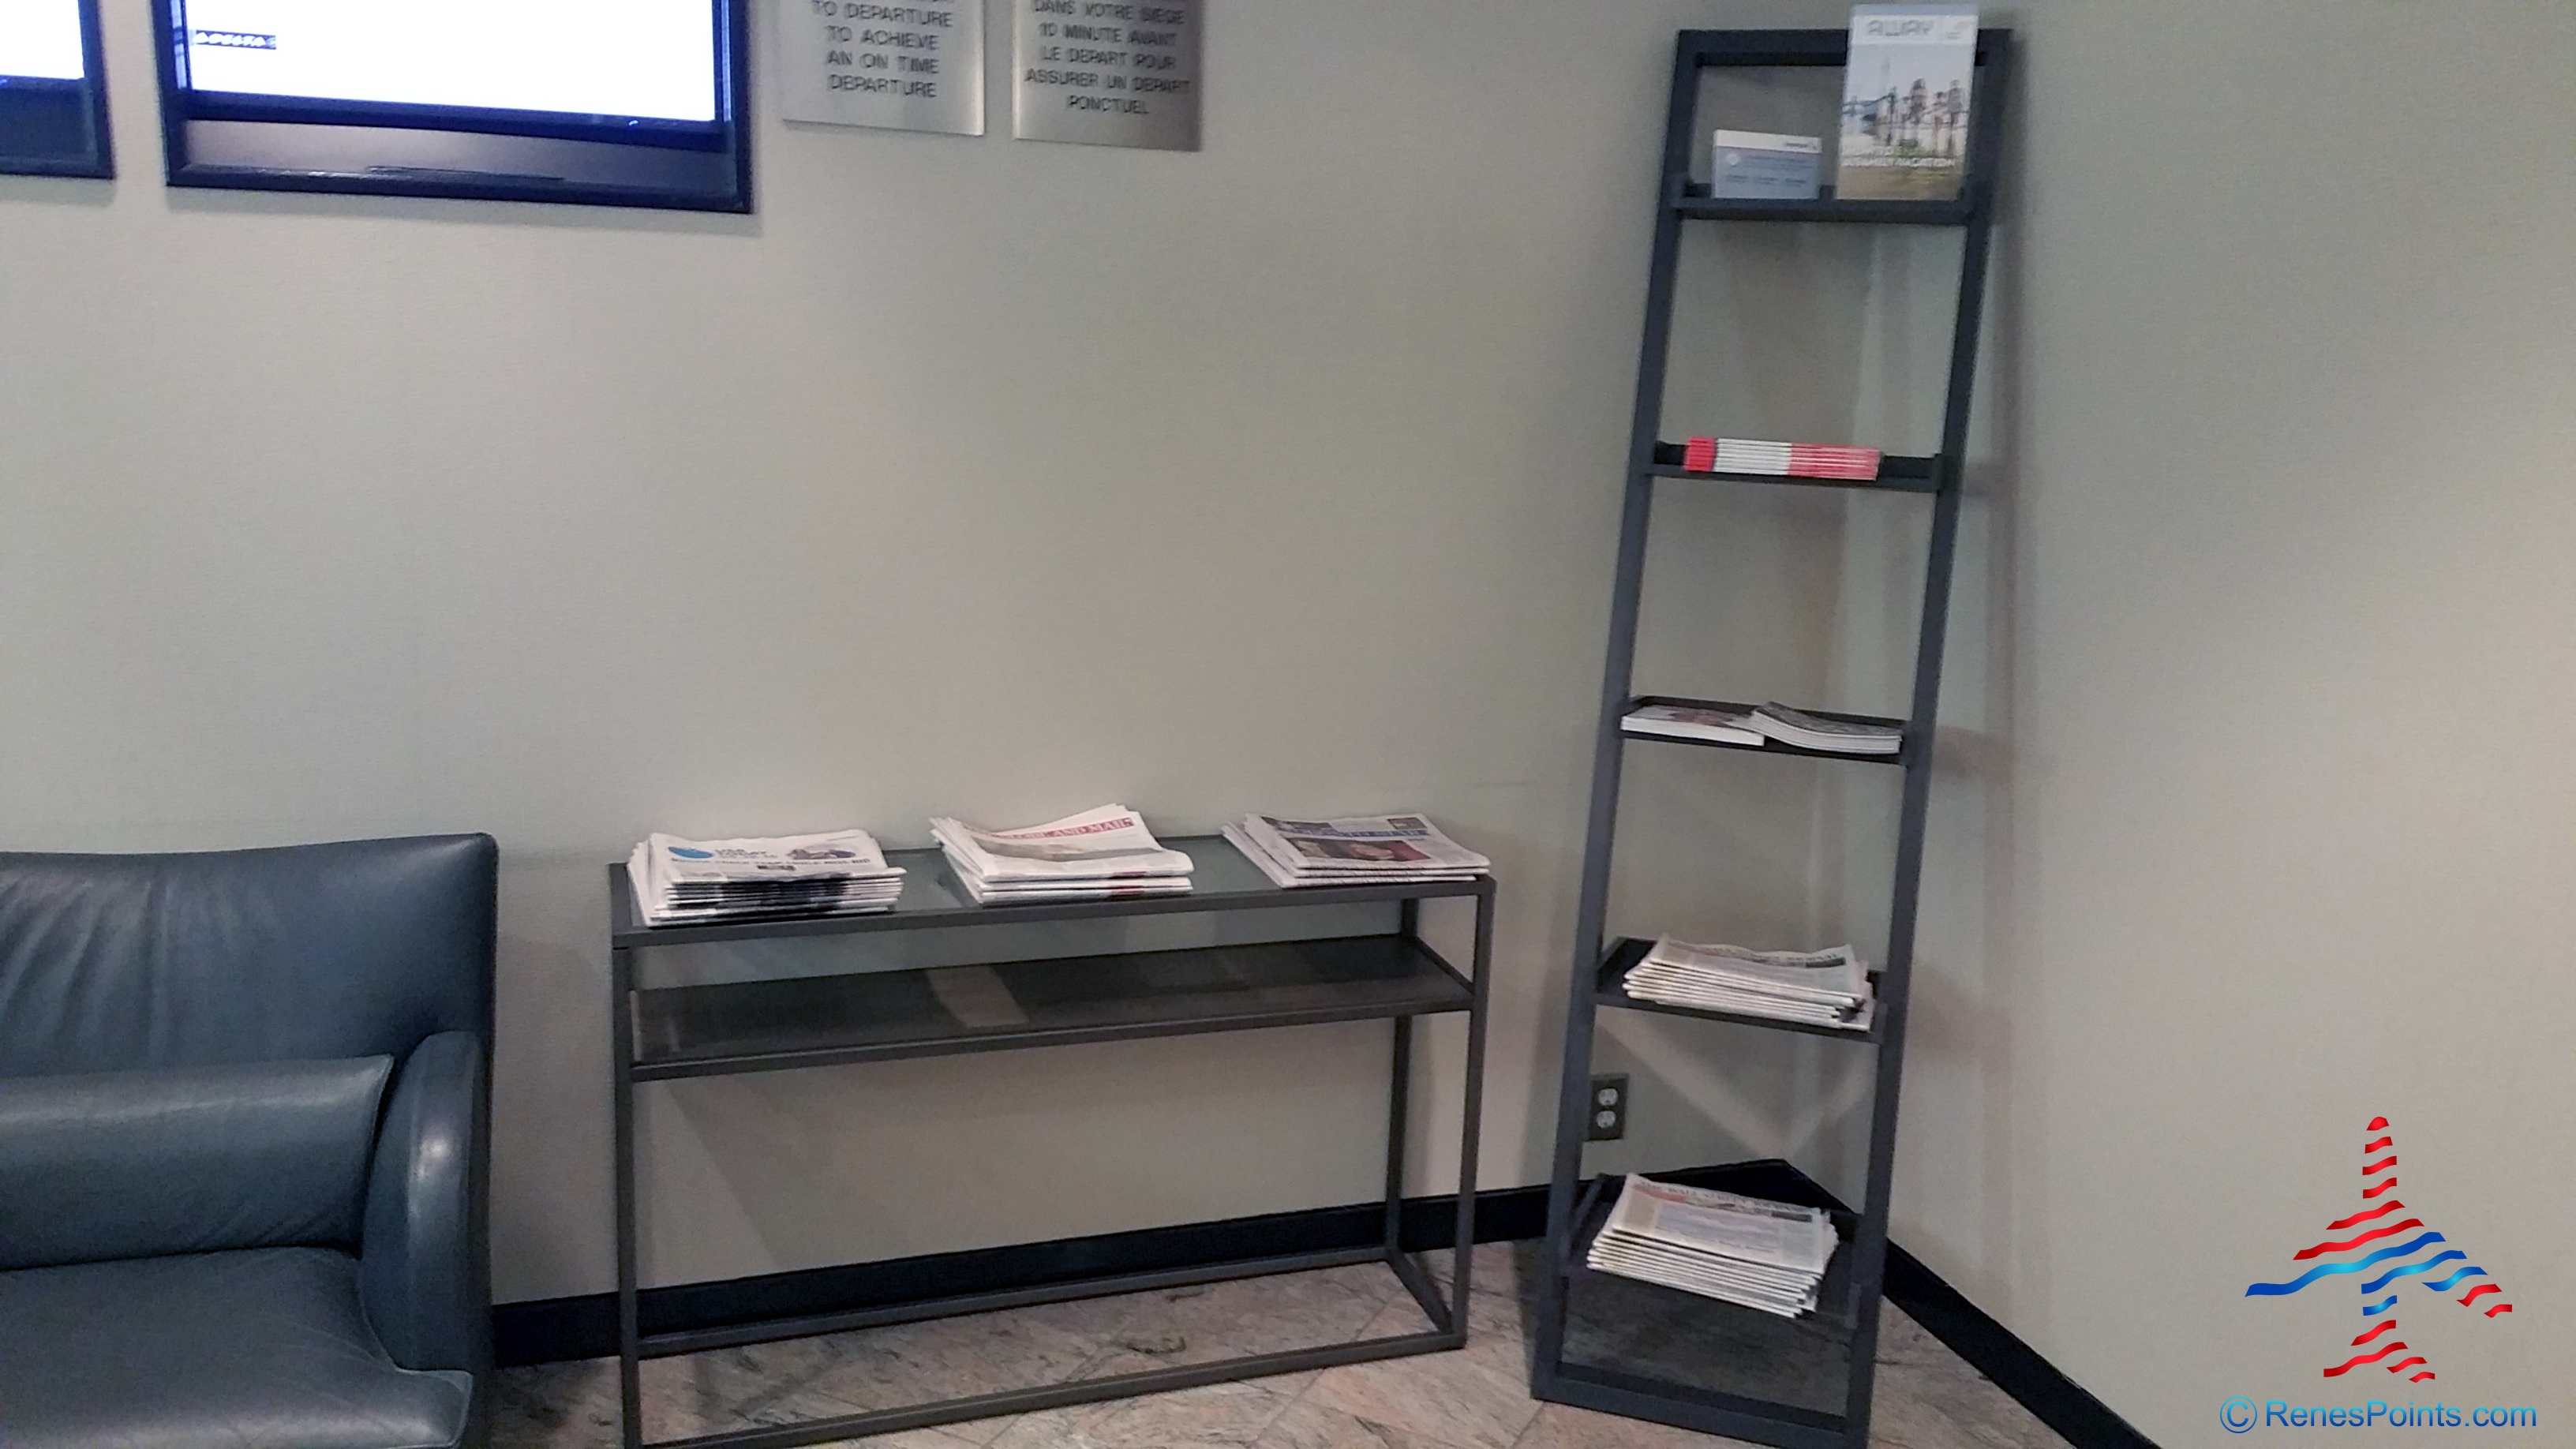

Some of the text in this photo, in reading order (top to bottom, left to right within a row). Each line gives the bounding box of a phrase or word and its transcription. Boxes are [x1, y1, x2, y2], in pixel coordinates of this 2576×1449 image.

[813, 0, 953, 28] TO DEPARTURE
[1034, 0, 1076, 14] DANS
[1085, 3, 1134, 20] VOTRE
[826, 25, 940, 50] TO ACHIEVE
[1039, 22, 1178, 46] 10 MINUTE AVANT
[827, 50, 940, 74] AN ON TIME
[1041, 46, 1177, 69] LE DEPART POUR
[829, 74, 938, 98] DEPARTURE
[1025, 69, 1190, 92] ASSURER UN DEPART
[1069, 95, 1149, 114] PONCTUEL
